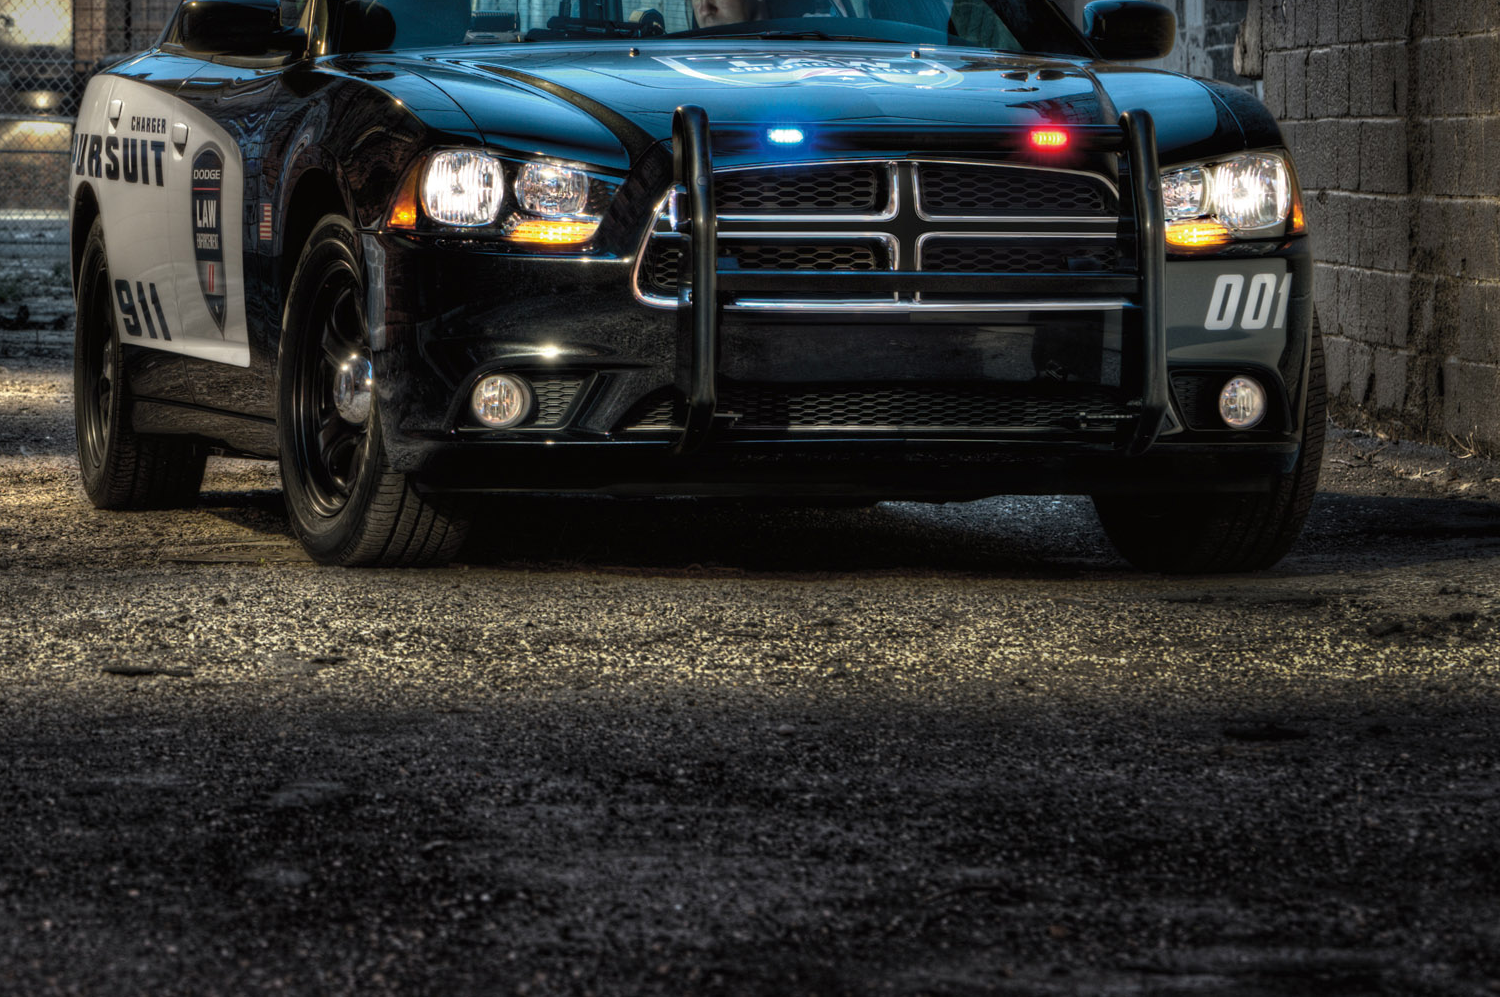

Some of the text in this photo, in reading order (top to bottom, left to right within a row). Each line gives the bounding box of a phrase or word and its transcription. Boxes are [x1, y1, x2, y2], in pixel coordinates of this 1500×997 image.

[131, 116, 166, 134] CHARGER
[193, 169, 221, 180] DODGE
[196, 200, 217, 228] LAW
[114, 279, 172, 341] 911
[1204, 273, 1292, 330] 001
